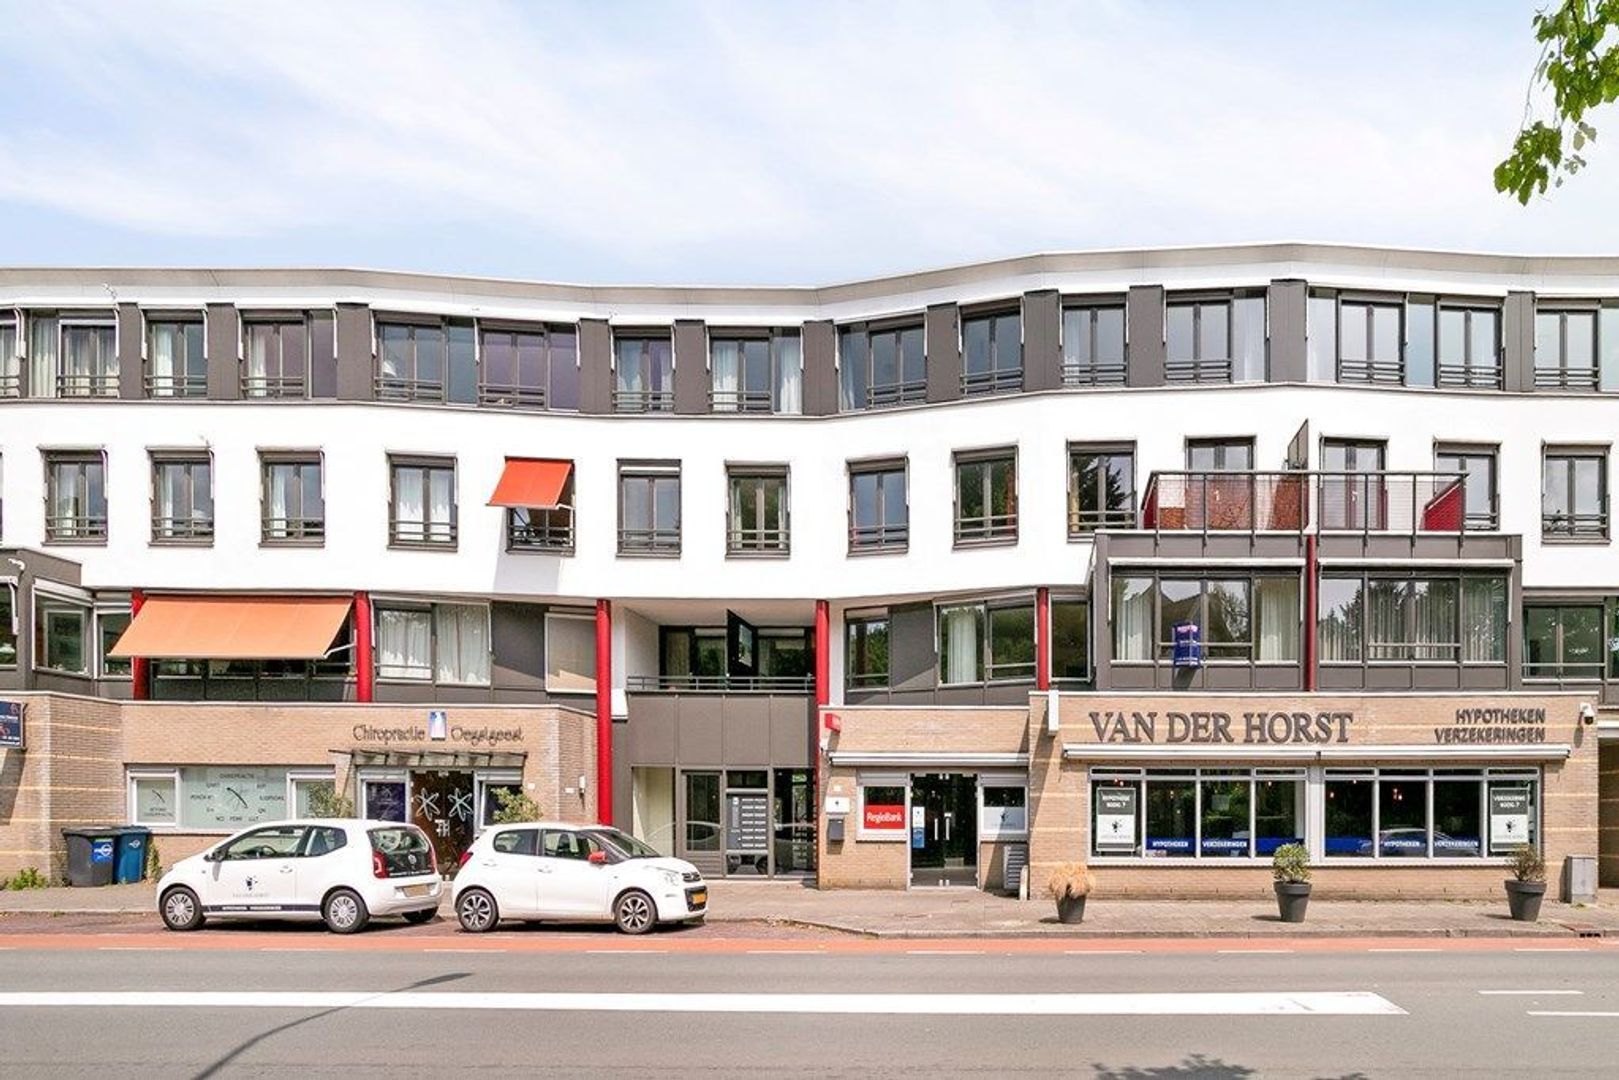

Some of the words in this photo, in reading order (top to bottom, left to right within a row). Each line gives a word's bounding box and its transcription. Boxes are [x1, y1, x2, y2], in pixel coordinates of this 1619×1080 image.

[1456, 708, 1545, 724] HYPOTHEKEN
[352, 724, 425, 745] Chiropractie
[1088, 711, 1158, 743] VAN
[1166, 711, 1234, 743] DER
[1243, 711, 1354, 743] HORST
[1434, 727, 1545, 743] VERZEKERINGEN
[866, 811, 902, 824] RegioBank
